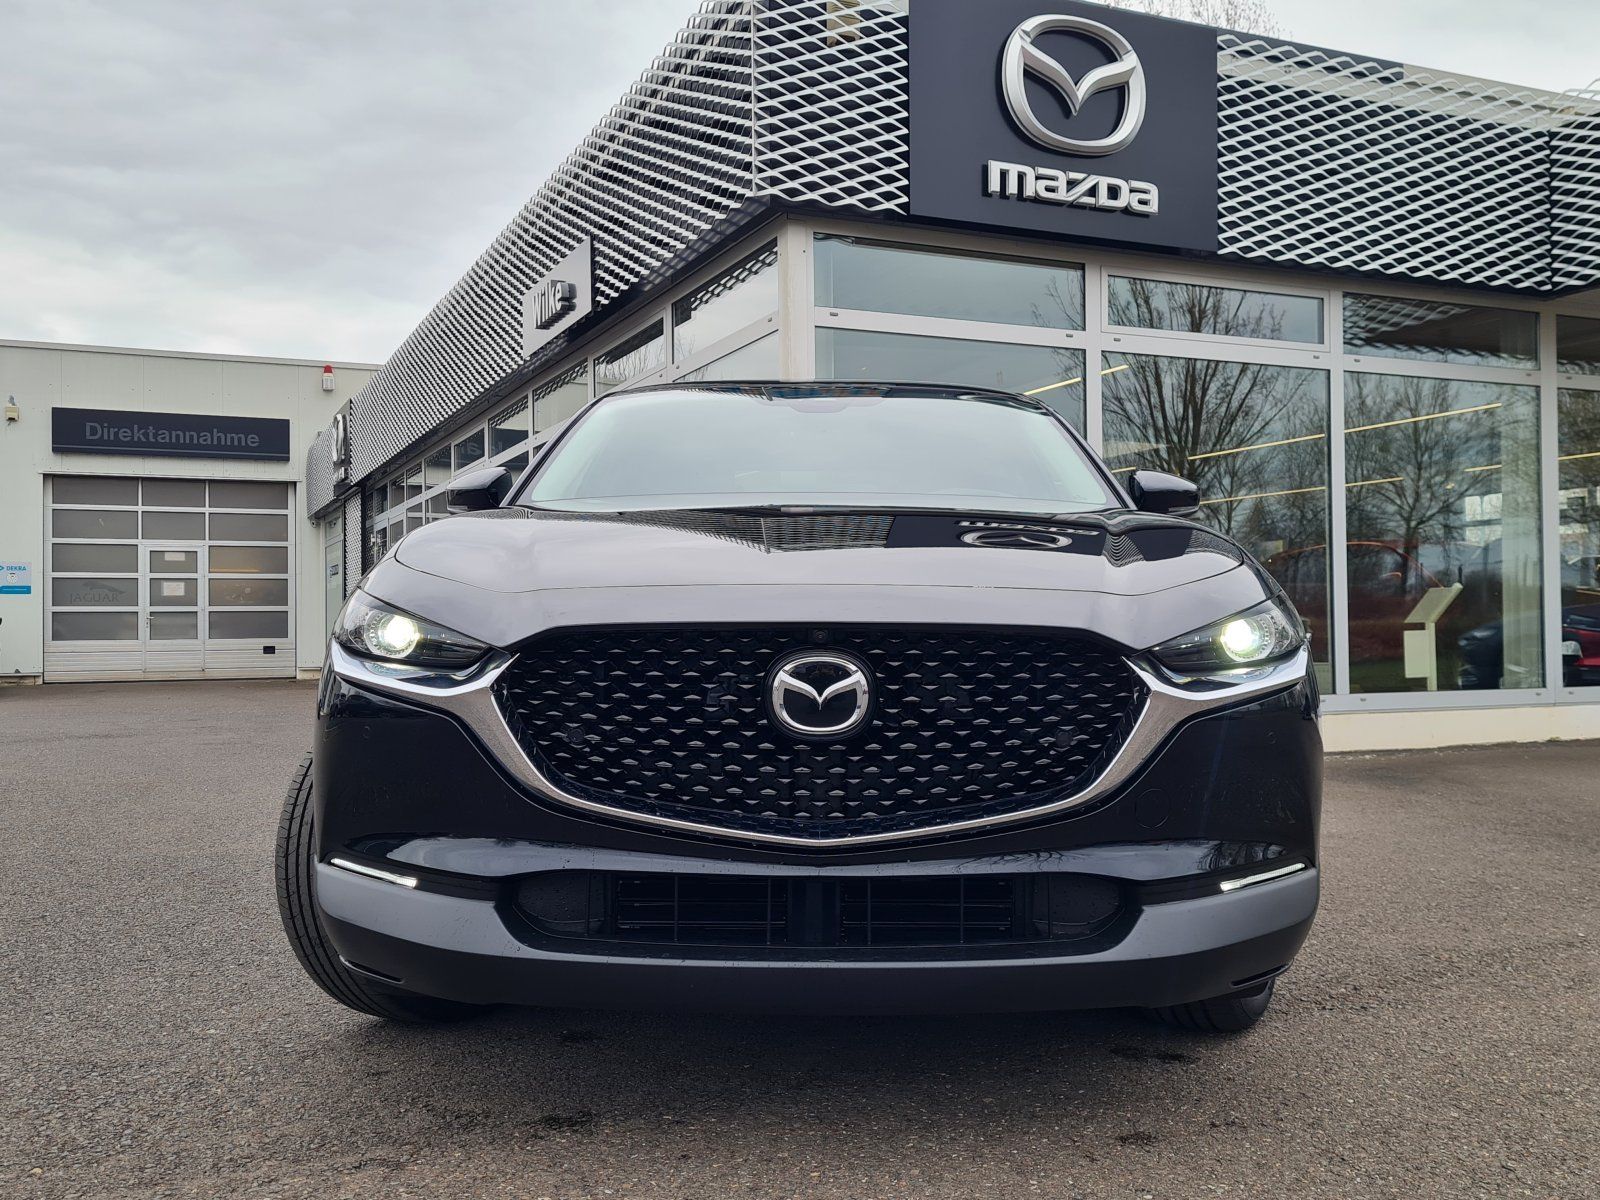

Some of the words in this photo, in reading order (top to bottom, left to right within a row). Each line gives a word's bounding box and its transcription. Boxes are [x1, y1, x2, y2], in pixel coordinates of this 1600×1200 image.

[532, 280, 570, 328] Wilke
[84, 422, 260, 447] Direktannahme
[70, 591, 120, 604] JAGUAR
